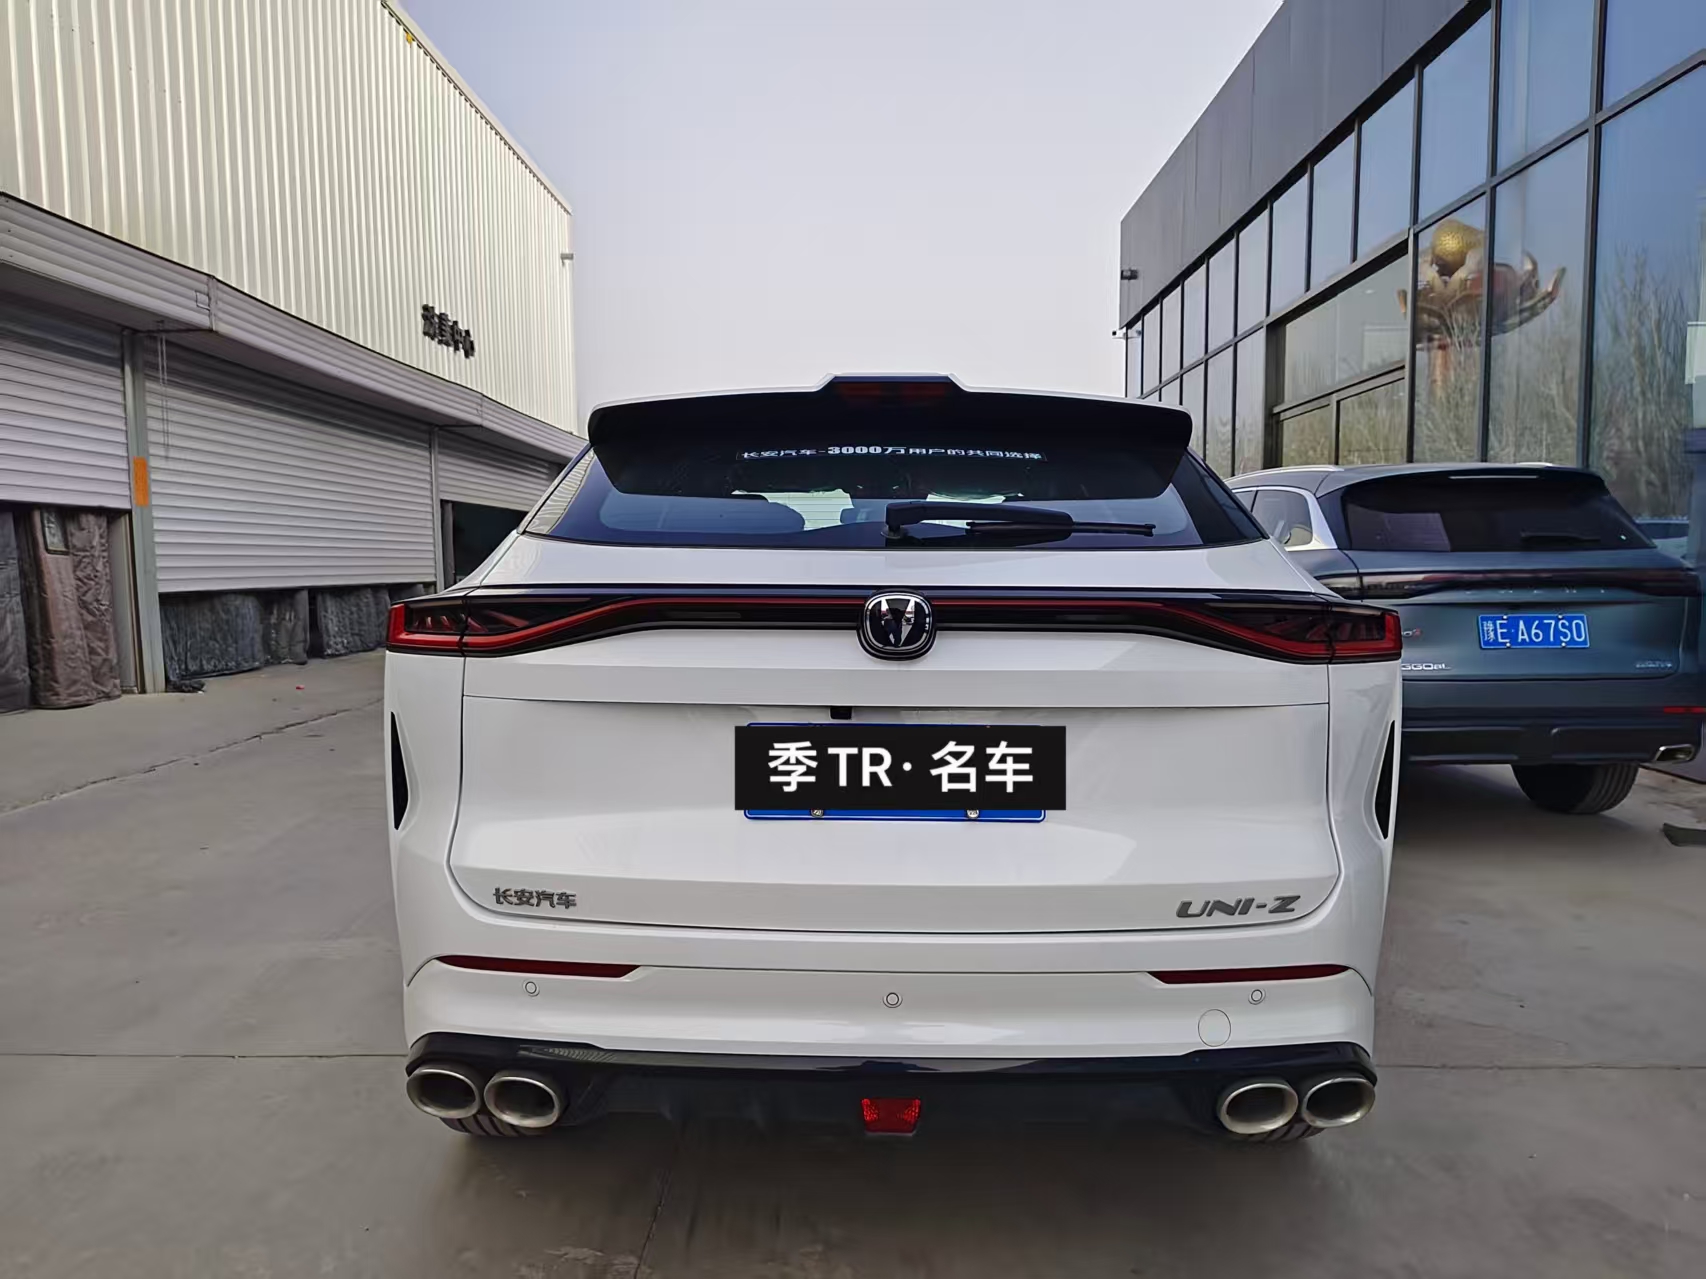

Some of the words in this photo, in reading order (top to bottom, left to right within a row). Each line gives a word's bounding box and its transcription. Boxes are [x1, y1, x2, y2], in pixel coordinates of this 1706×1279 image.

[492, 887, 577, 909] 长安汽车
[1176, 895, 1301, 918] UNI-Z
